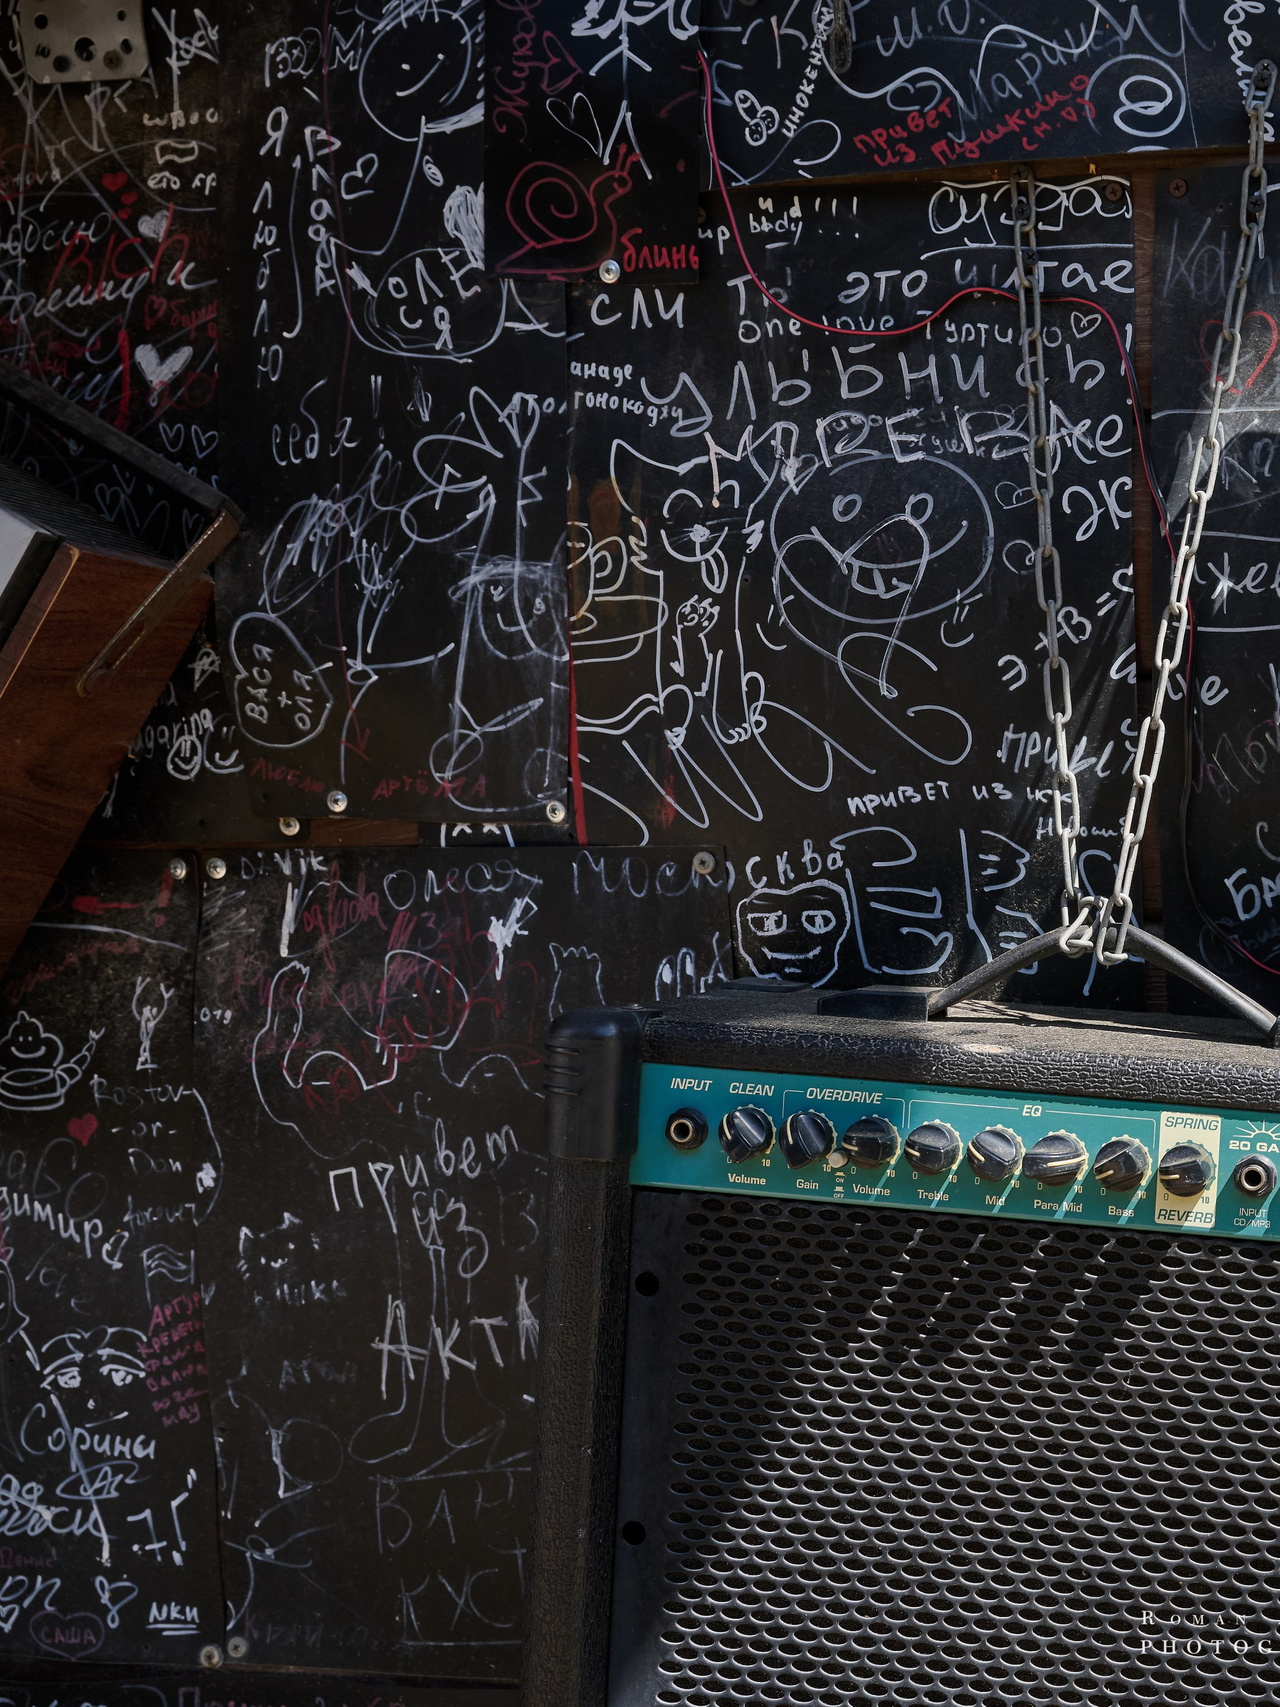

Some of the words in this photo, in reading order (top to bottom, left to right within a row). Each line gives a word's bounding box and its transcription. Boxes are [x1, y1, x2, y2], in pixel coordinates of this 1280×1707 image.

[853, 97, 952, 152] привет
[873, 142, 917, 168] из
[372, 769, 487, 800] АРТЁМА
[847, 780, 951, 816] ПРИВЕТ
[972, 782, 1012, 801] ИЗ
[670, 1077, 713, 1092] INPUT
[729, 1082, 775, 1097] CLEAN
[806, 1087, 883, 1105] OVERDRIVE
[1022, 1104, 1043, 1117] EQ
[1165, 1116, 1219, 1132] SPRING
[1229, 1140, 1251, 1151] 20
[1256, 1142, 1279, 1153] GA
[761, 1158, 771, 1167] 10
[822, 1164, 832, 1173] 10
[328, 1124, 519, 1235] Привет
[728, 1173, 767, 1186] Volume
[886, 1169, 896, 1178] 10
[948, 1174, 958, 1183] 10
[796, 1178, 819, 1191] Gain
[852, 1183, 891, 1197] Volume
[1010, 1180, 1020, 1189] 10
[1073, 1185, 1083, 1194] 10
[917, 1189, 950, 1202] Treble
[985, 1195, 1006, 1207] Mid
[1137, 1191, 1147, 1199] 10
[1200, 1196, 1210, 1205] 10
[1033, 1200, 1060, 1212] Para
[1062, 1201, 1083, 1213] Mid
[1108, 1206, 1135, 1217] Bass
[1239, 1207, 1268, 1218] INPUT
[1157, 1208, 1215, 1225] REVERB
[1233, 1217, 1272, 1229] CD/MP3
